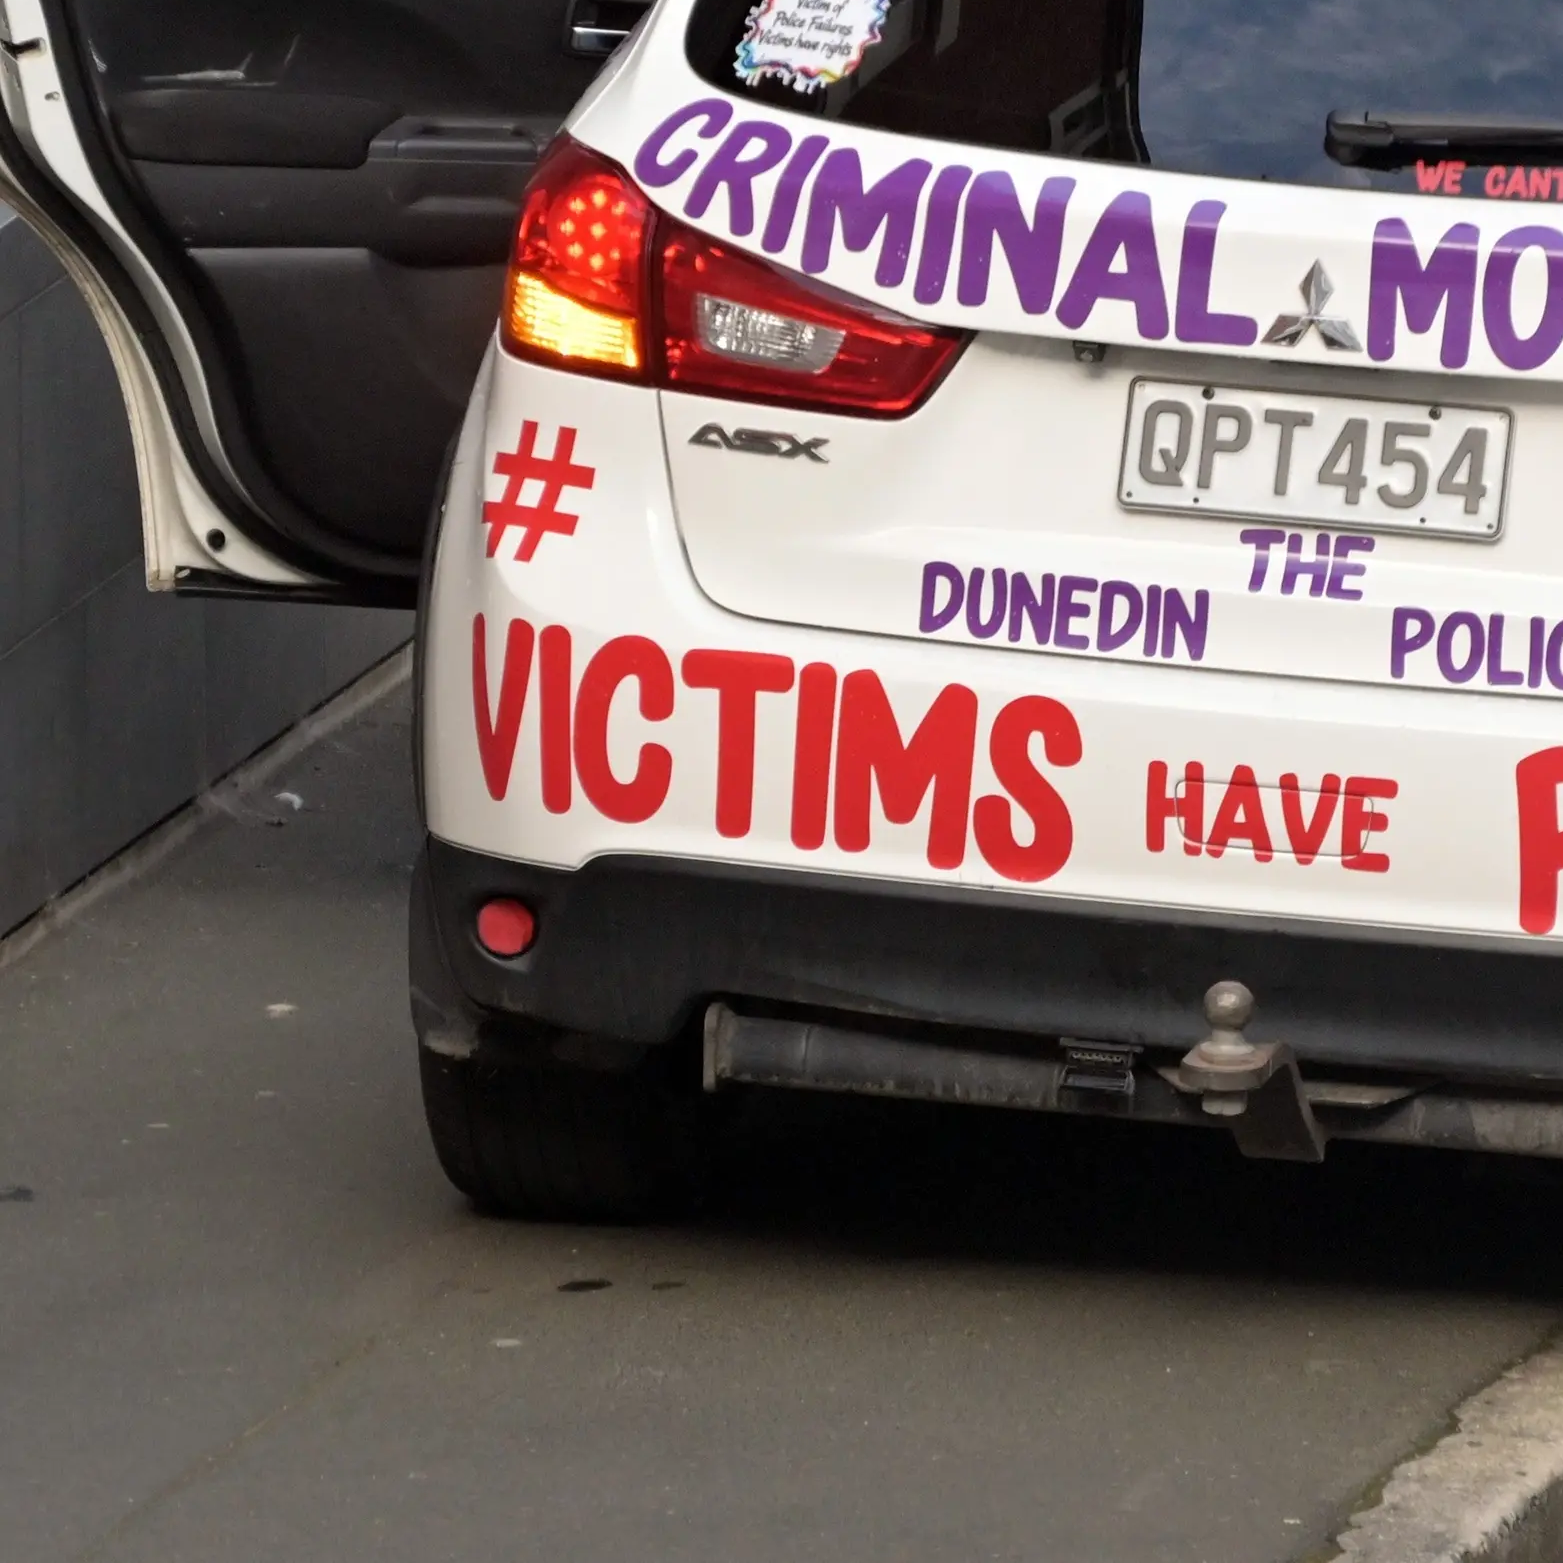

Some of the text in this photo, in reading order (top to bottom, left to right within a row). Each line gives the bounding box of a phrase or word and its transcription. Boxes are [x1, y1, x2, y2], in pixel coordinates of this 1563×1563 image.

[772, 10, 854, 36] Police Failures
[832, 0, 850, 18] of
[758, 29, 853, 60] Victims have rights
[1414, 159, 1466, 195] WE
[634, 97, 1258, 346] CRIMINAL
[687, 421, 831, 464] ASX
[1137, 398, 1491, 515] QPT454
[1239, 528, 1376, 601] THE
[918, 560, 1210, 662] DUNEDIN
[472, 610, 1083, 883] VICTIMS
[1145, 759, 1400, 874] HAVE
